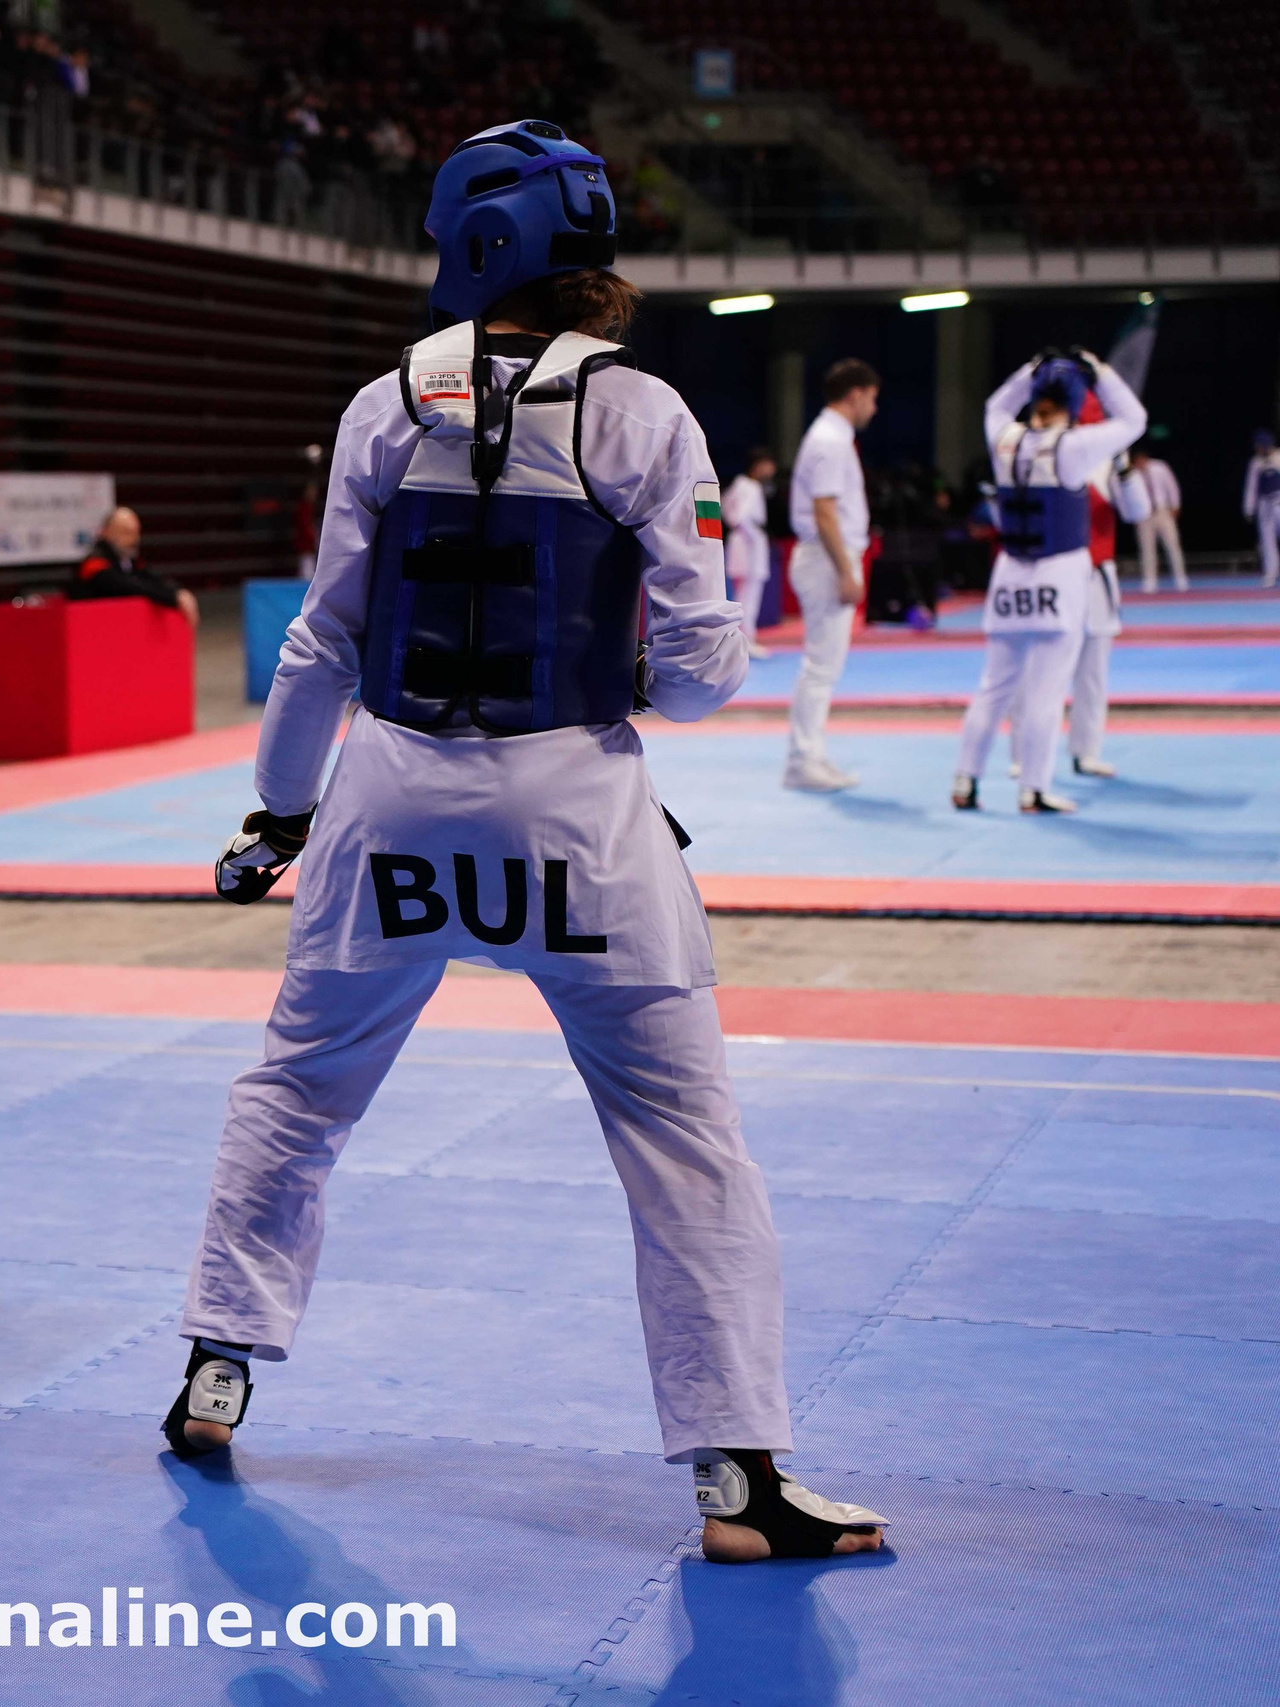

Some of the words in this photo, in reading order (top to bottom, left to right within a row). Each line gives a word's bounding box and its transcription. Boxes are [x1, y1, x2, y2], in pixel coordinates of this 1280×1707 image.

[994, 586, 1059, 617] GBR
[370, 853, 607, 953] BUL
[212, 1399, 229, 1411] K2
[696, 1490, 710, 1502] K2
